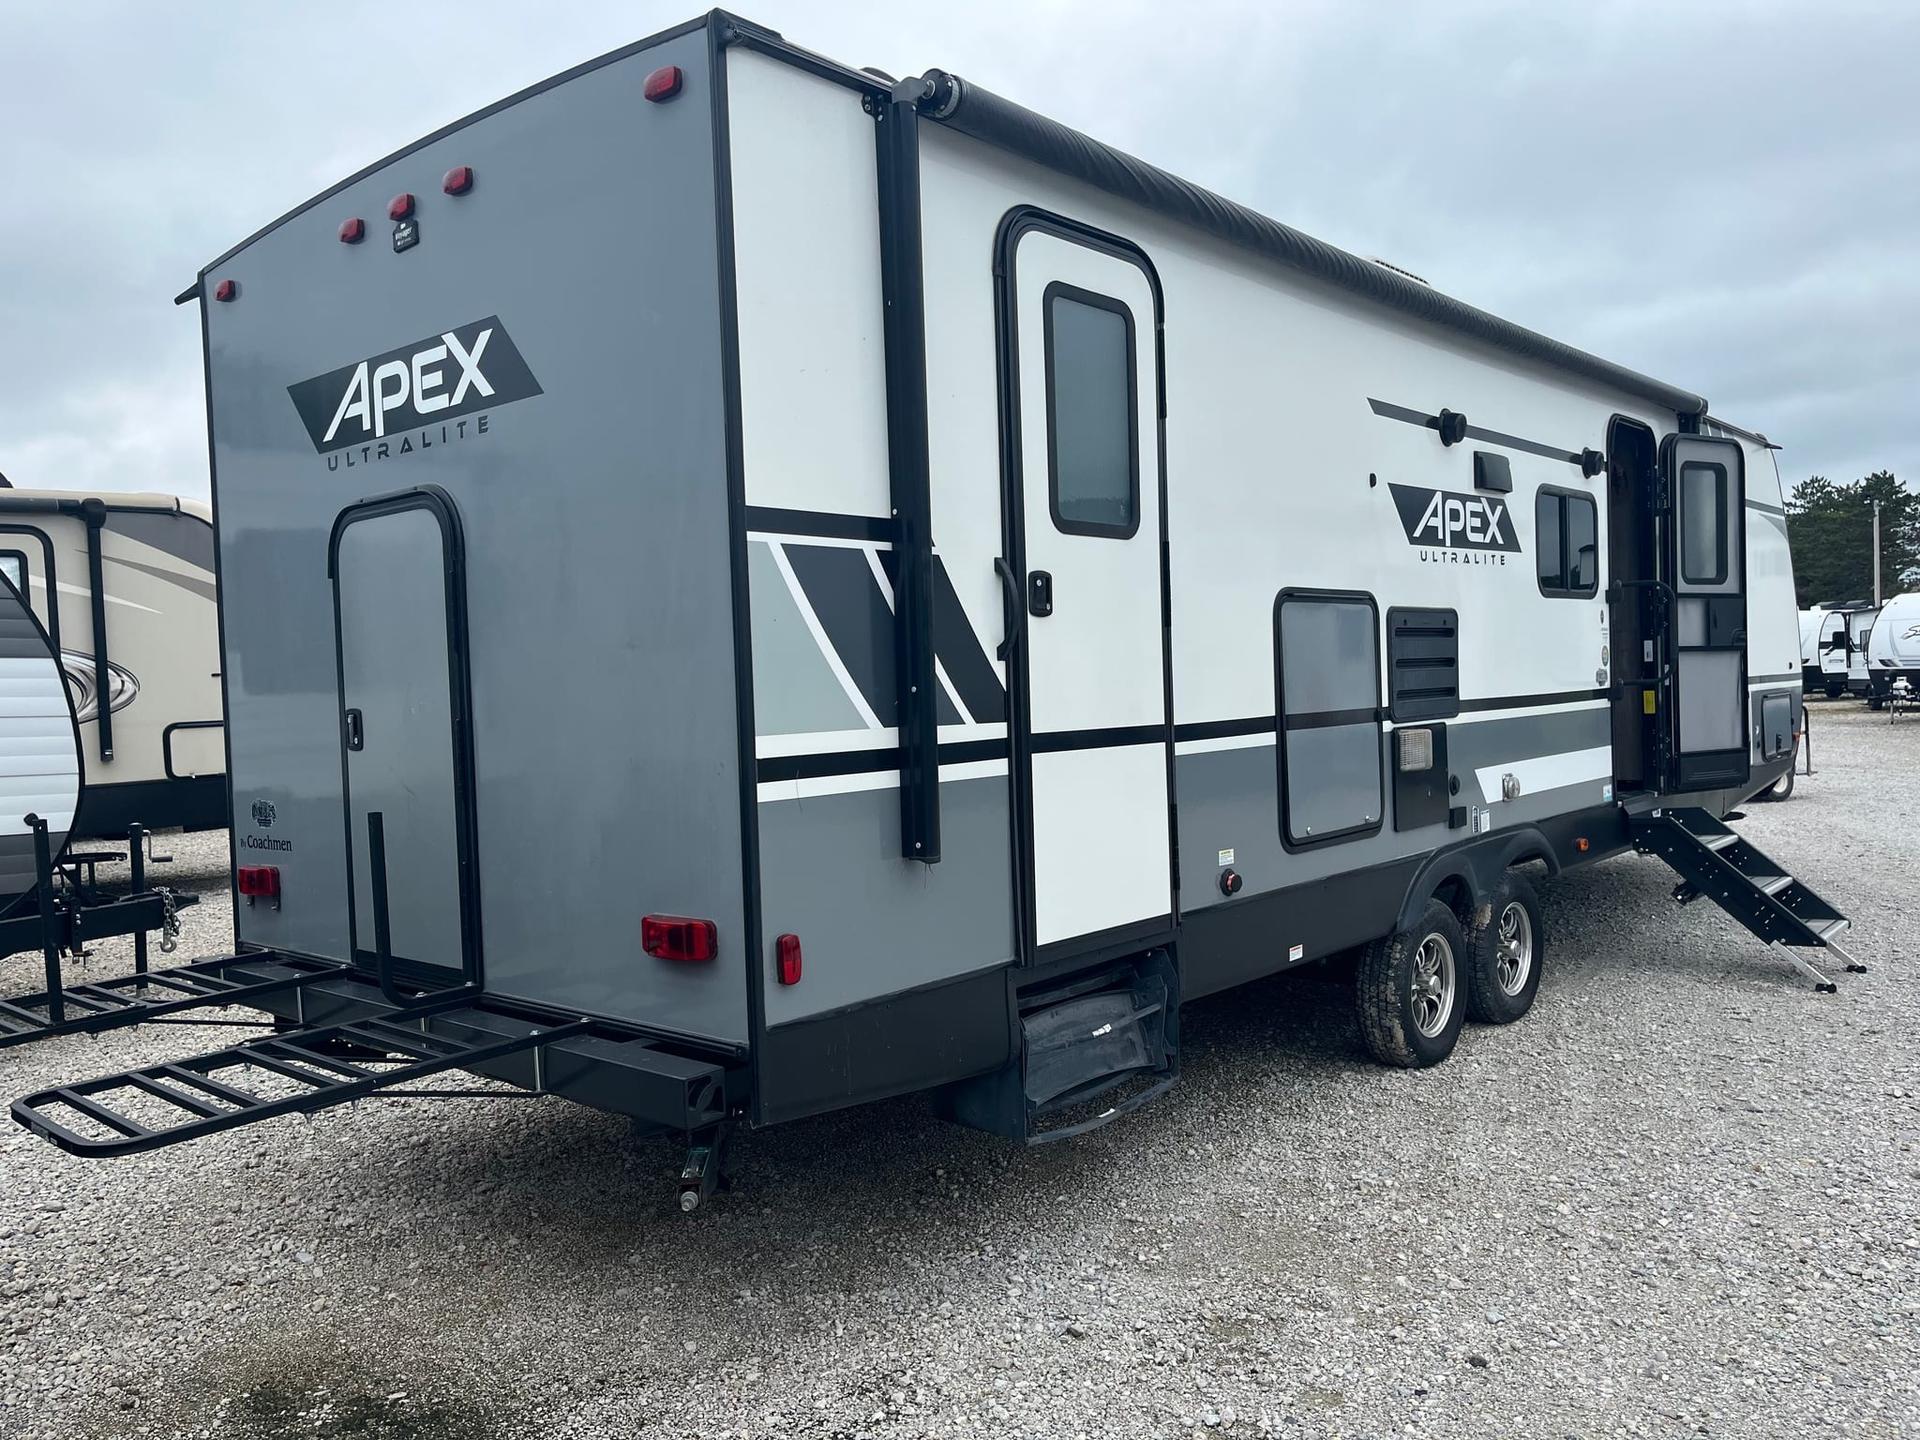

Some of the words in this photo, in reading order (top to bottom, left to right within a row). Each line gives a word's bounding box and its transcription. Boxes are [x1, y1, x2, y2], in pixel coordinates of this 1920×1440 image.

[322, 328, 496, 443] APEX
[327, 415, 489, 471] ULTRALITE
[1412, 491, 1505, 547] APEX
[1420, 550, 1506, 566] ULTRALITE
[246, 834, 293, 852] Coachmen
